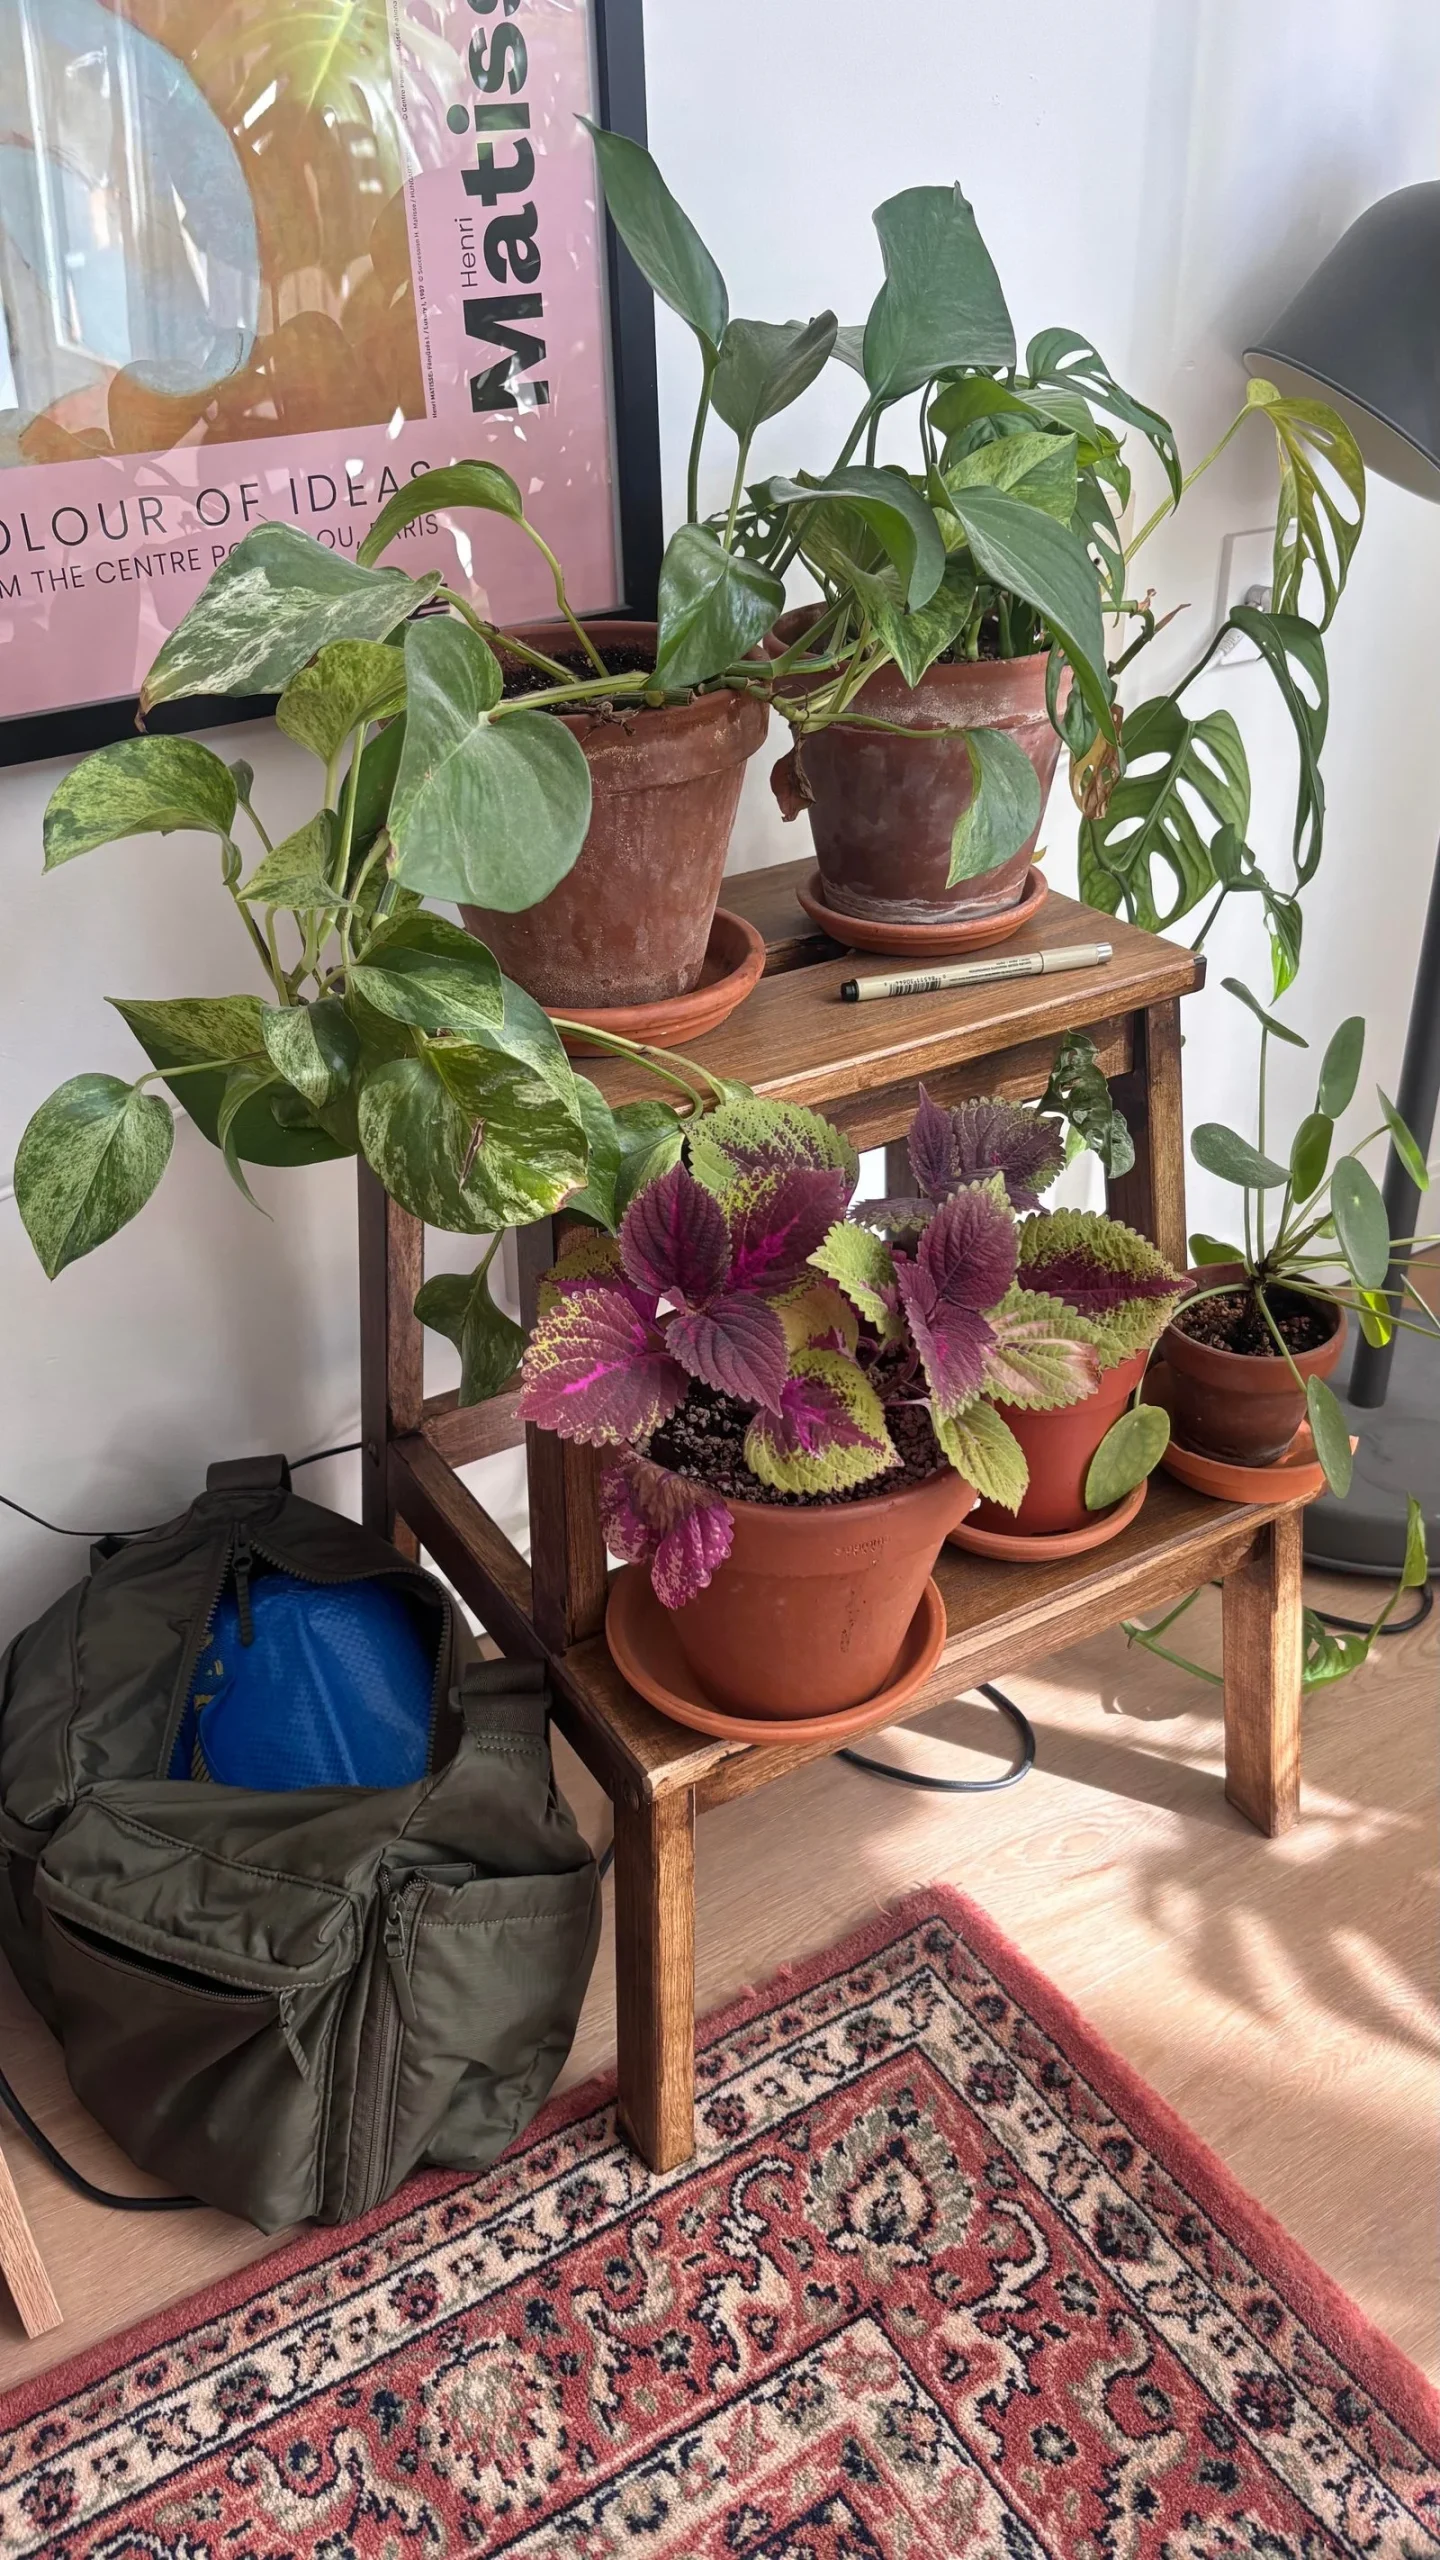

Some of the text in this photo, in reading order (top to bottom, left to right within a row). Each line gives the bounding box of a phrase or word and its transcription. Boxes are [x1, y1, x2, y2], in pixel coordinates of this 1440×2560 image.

[447, 0, 550, 413] Matis
[454, 216, 478, 288] Henri
[197, 483, 259, 526] OF
[30, 565, 86, 593] THE
[95, 548, 202, 585] CENTRE
